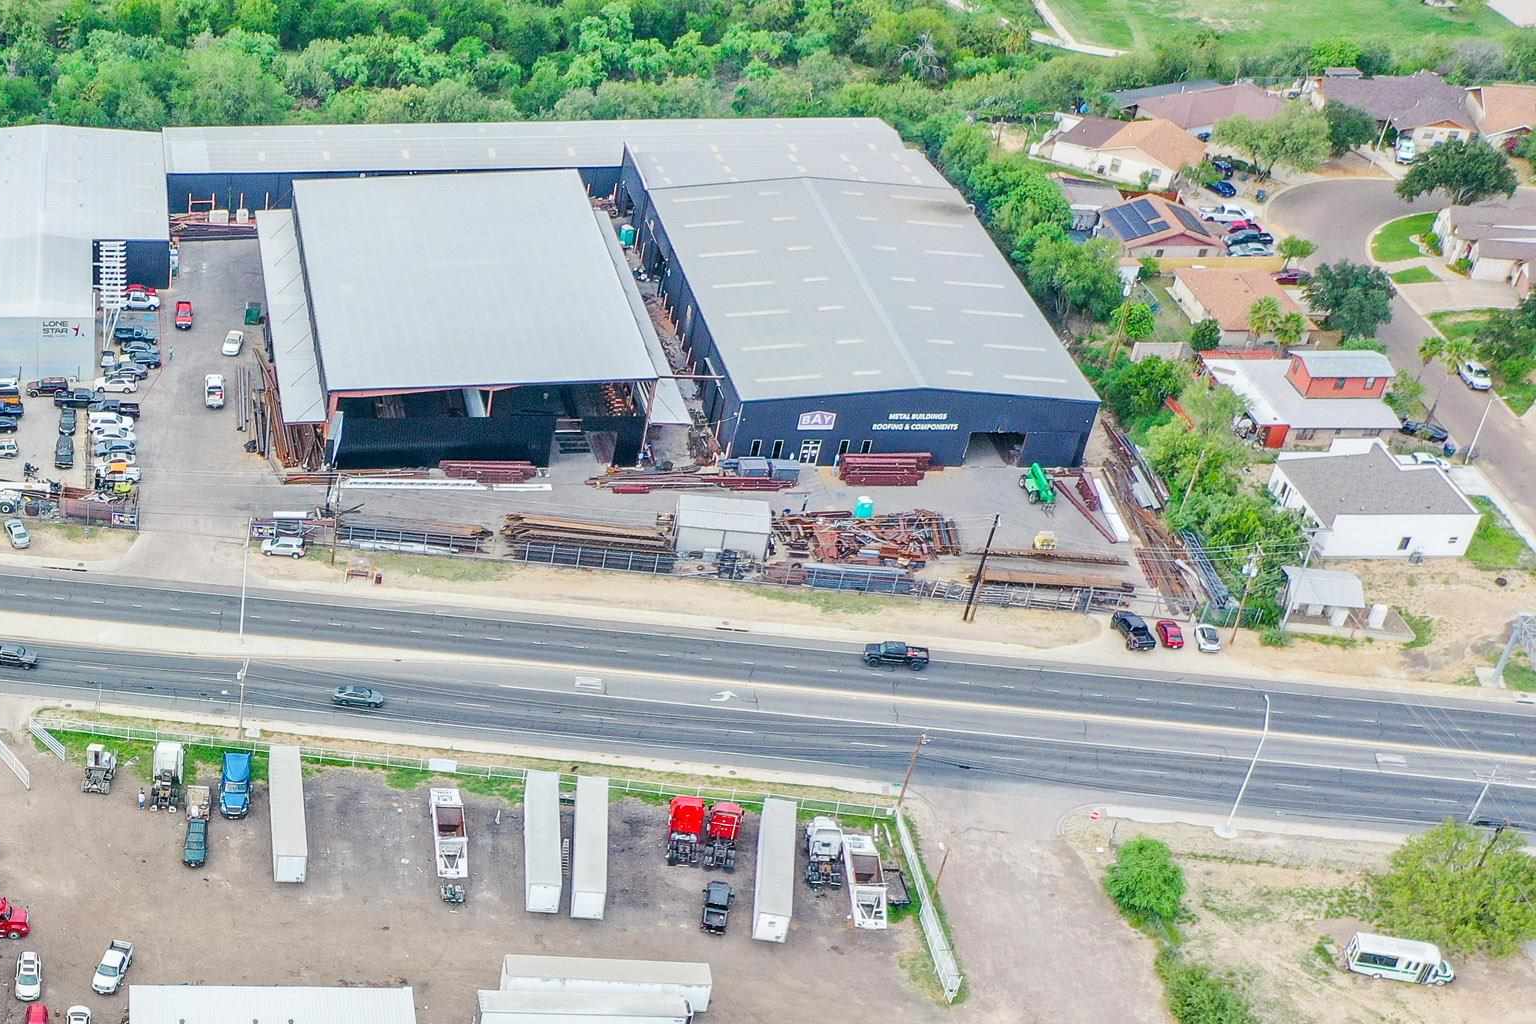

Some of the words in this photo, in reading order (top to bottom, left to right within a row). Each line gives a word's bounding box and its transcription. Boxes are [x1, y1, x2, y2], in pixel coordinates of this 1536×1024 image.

[802, 415, 833, 425] BAY
[872, 423, 903, 431] ROOFING
[911, 423, 959, 431] COMPONENTS
